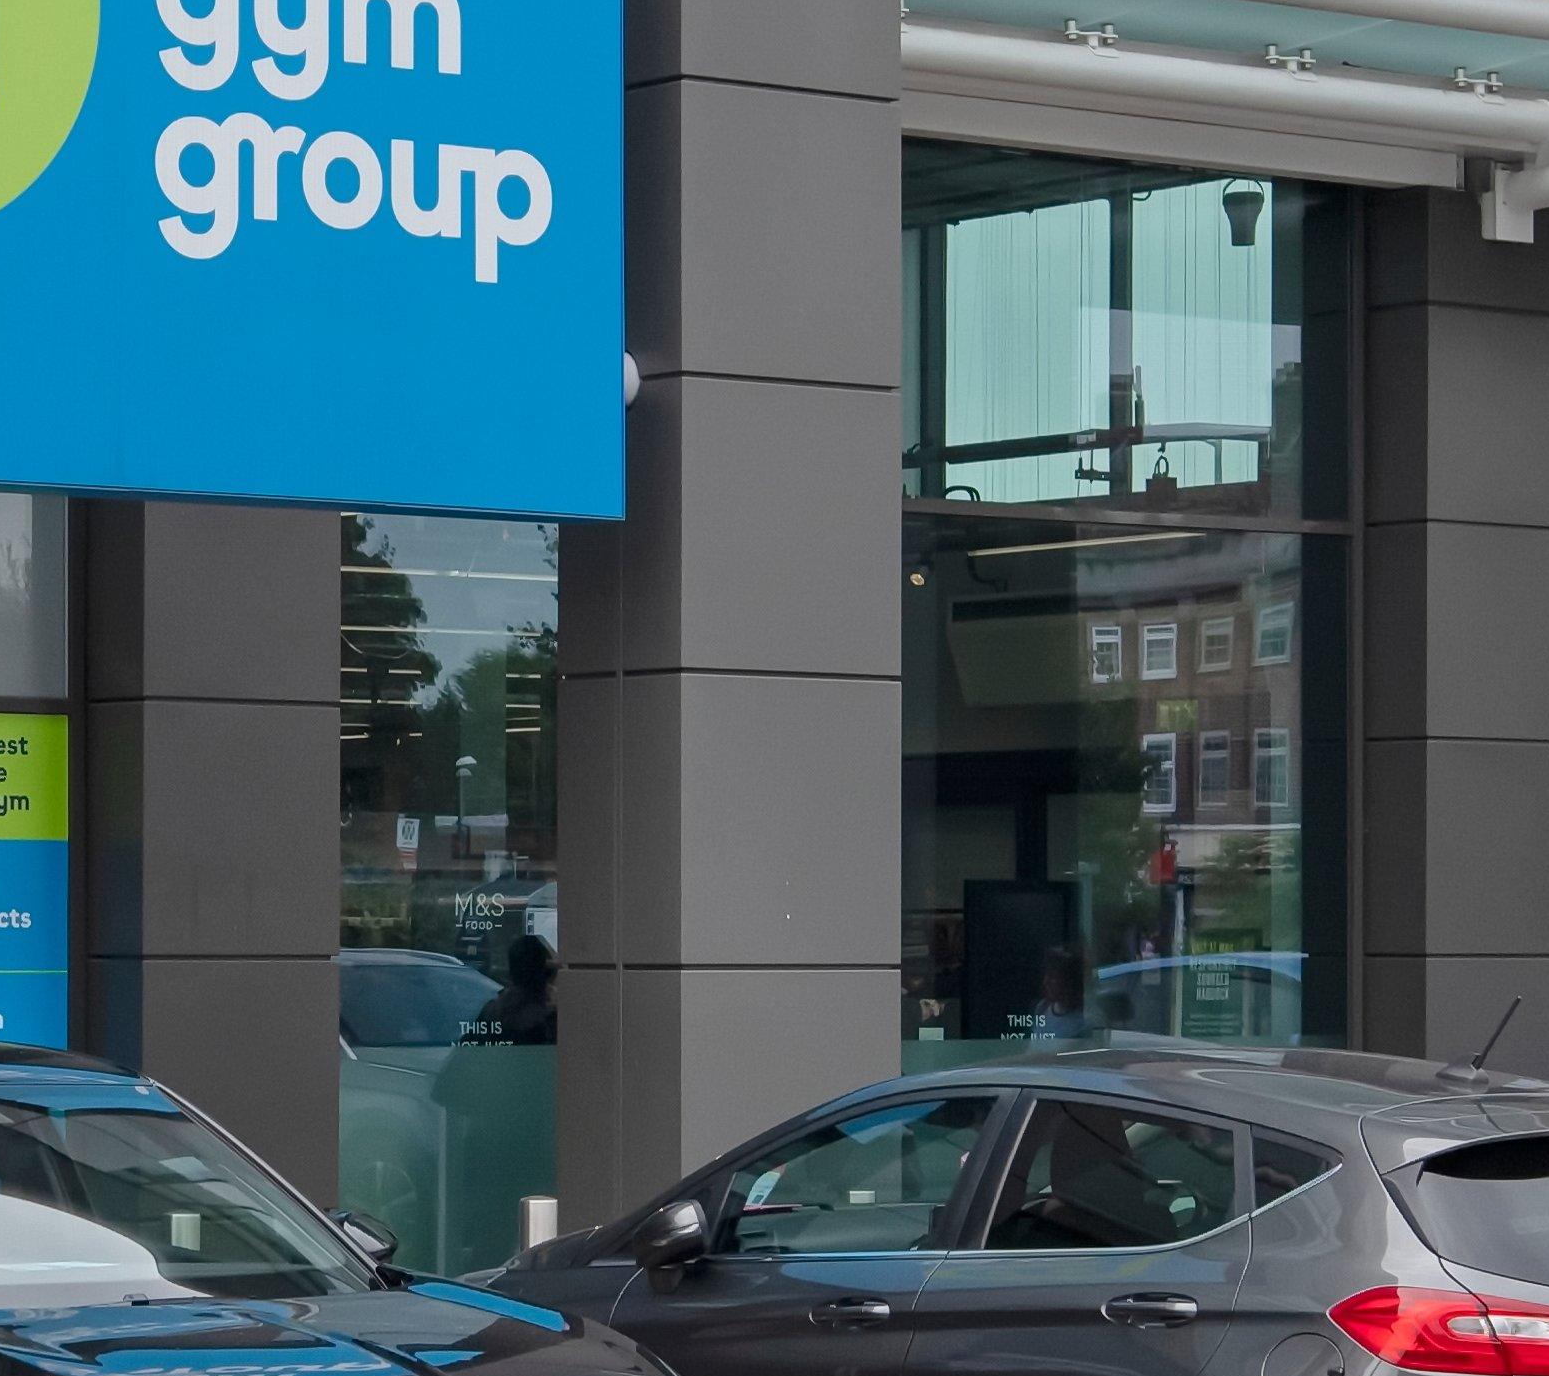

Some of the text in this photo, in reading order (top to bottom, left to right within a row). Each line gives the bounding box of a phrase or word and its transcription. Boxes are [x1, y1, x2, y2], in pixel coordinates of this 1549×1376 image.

[155, 113, 554, 283] group
[454, 892, 505, 917] M&S
[458, 1021, 503, 1035] THIS IS
[1006, 1014, 1046, 1028] THIS IS
